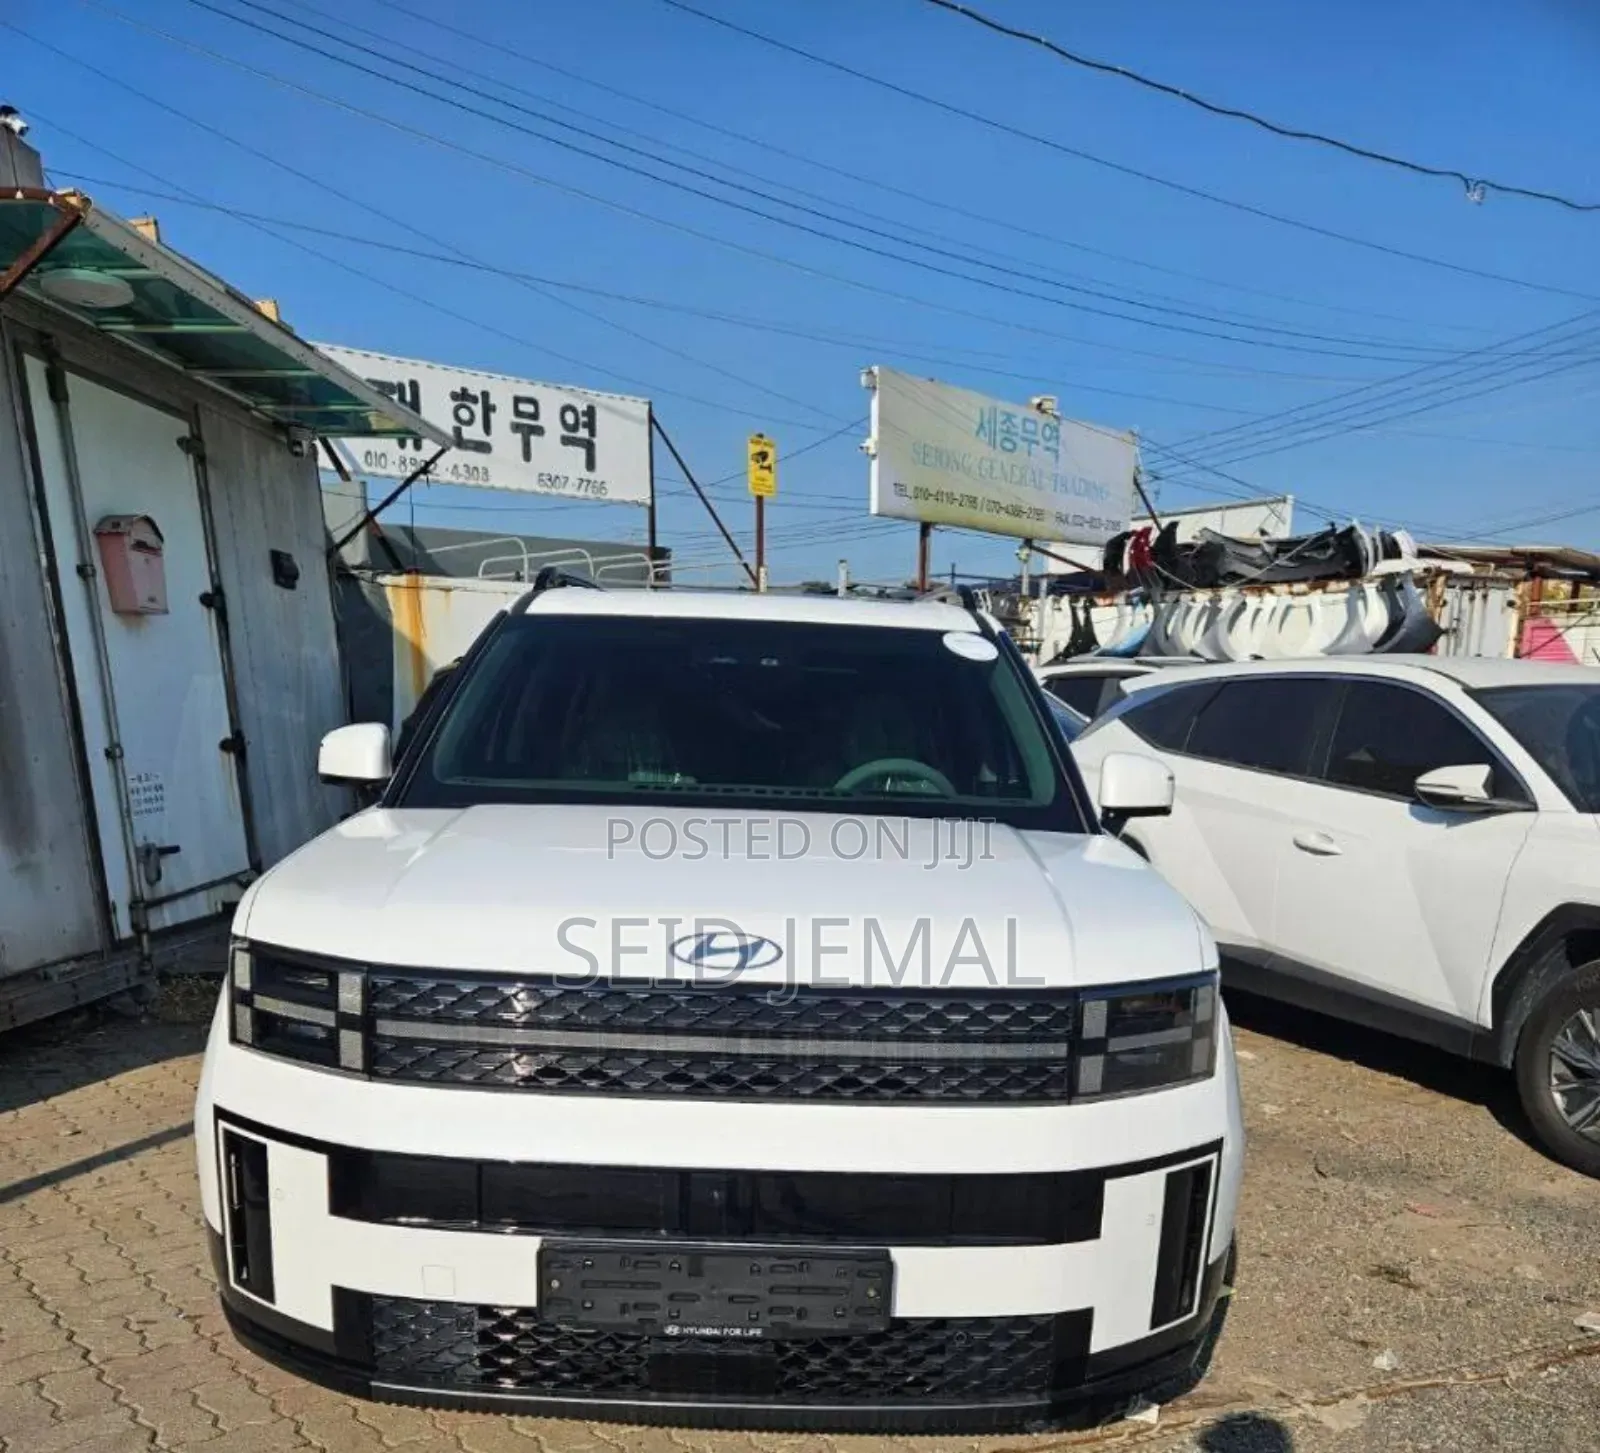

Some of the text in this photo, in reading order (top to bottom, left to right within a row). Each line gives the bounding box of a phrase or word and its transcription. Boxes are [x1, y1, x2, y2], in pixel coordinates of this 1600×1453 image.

[976, 406, 1059, 463] 세종무역
[978, 455, 1044, 491] GENERAL
[682, 1326, 763, 1337] HYUNDAI FOR LIFE
